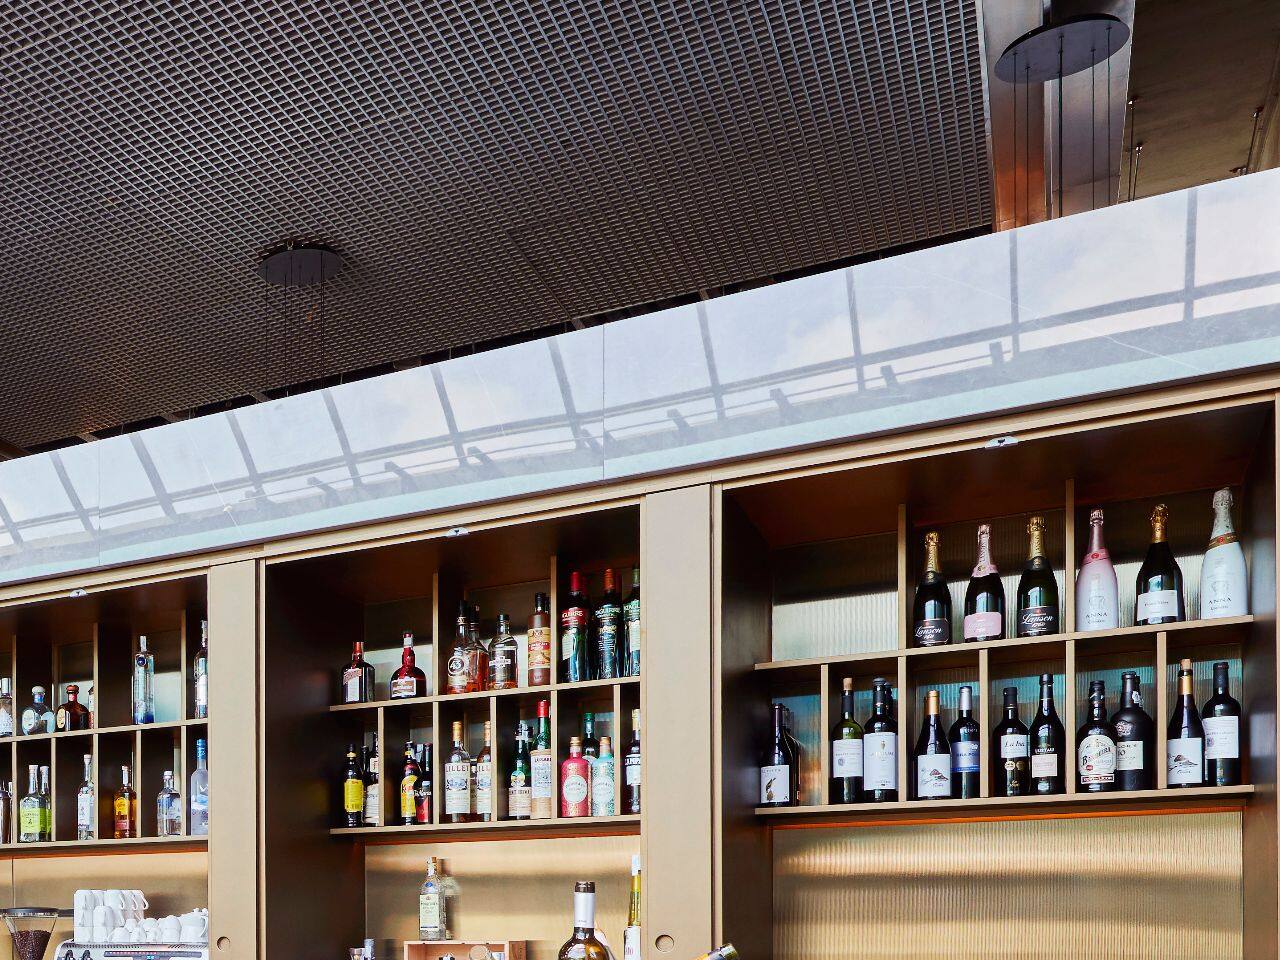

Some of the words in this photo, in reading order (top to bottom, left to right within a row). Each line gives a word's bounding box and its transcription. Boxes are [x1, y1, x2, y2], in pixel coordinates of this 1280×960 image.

[1022, 612, 1053, 623] Lanson
[915, 625, 942, 638] Lanson
[445, 764, 470, 773] LILLET
